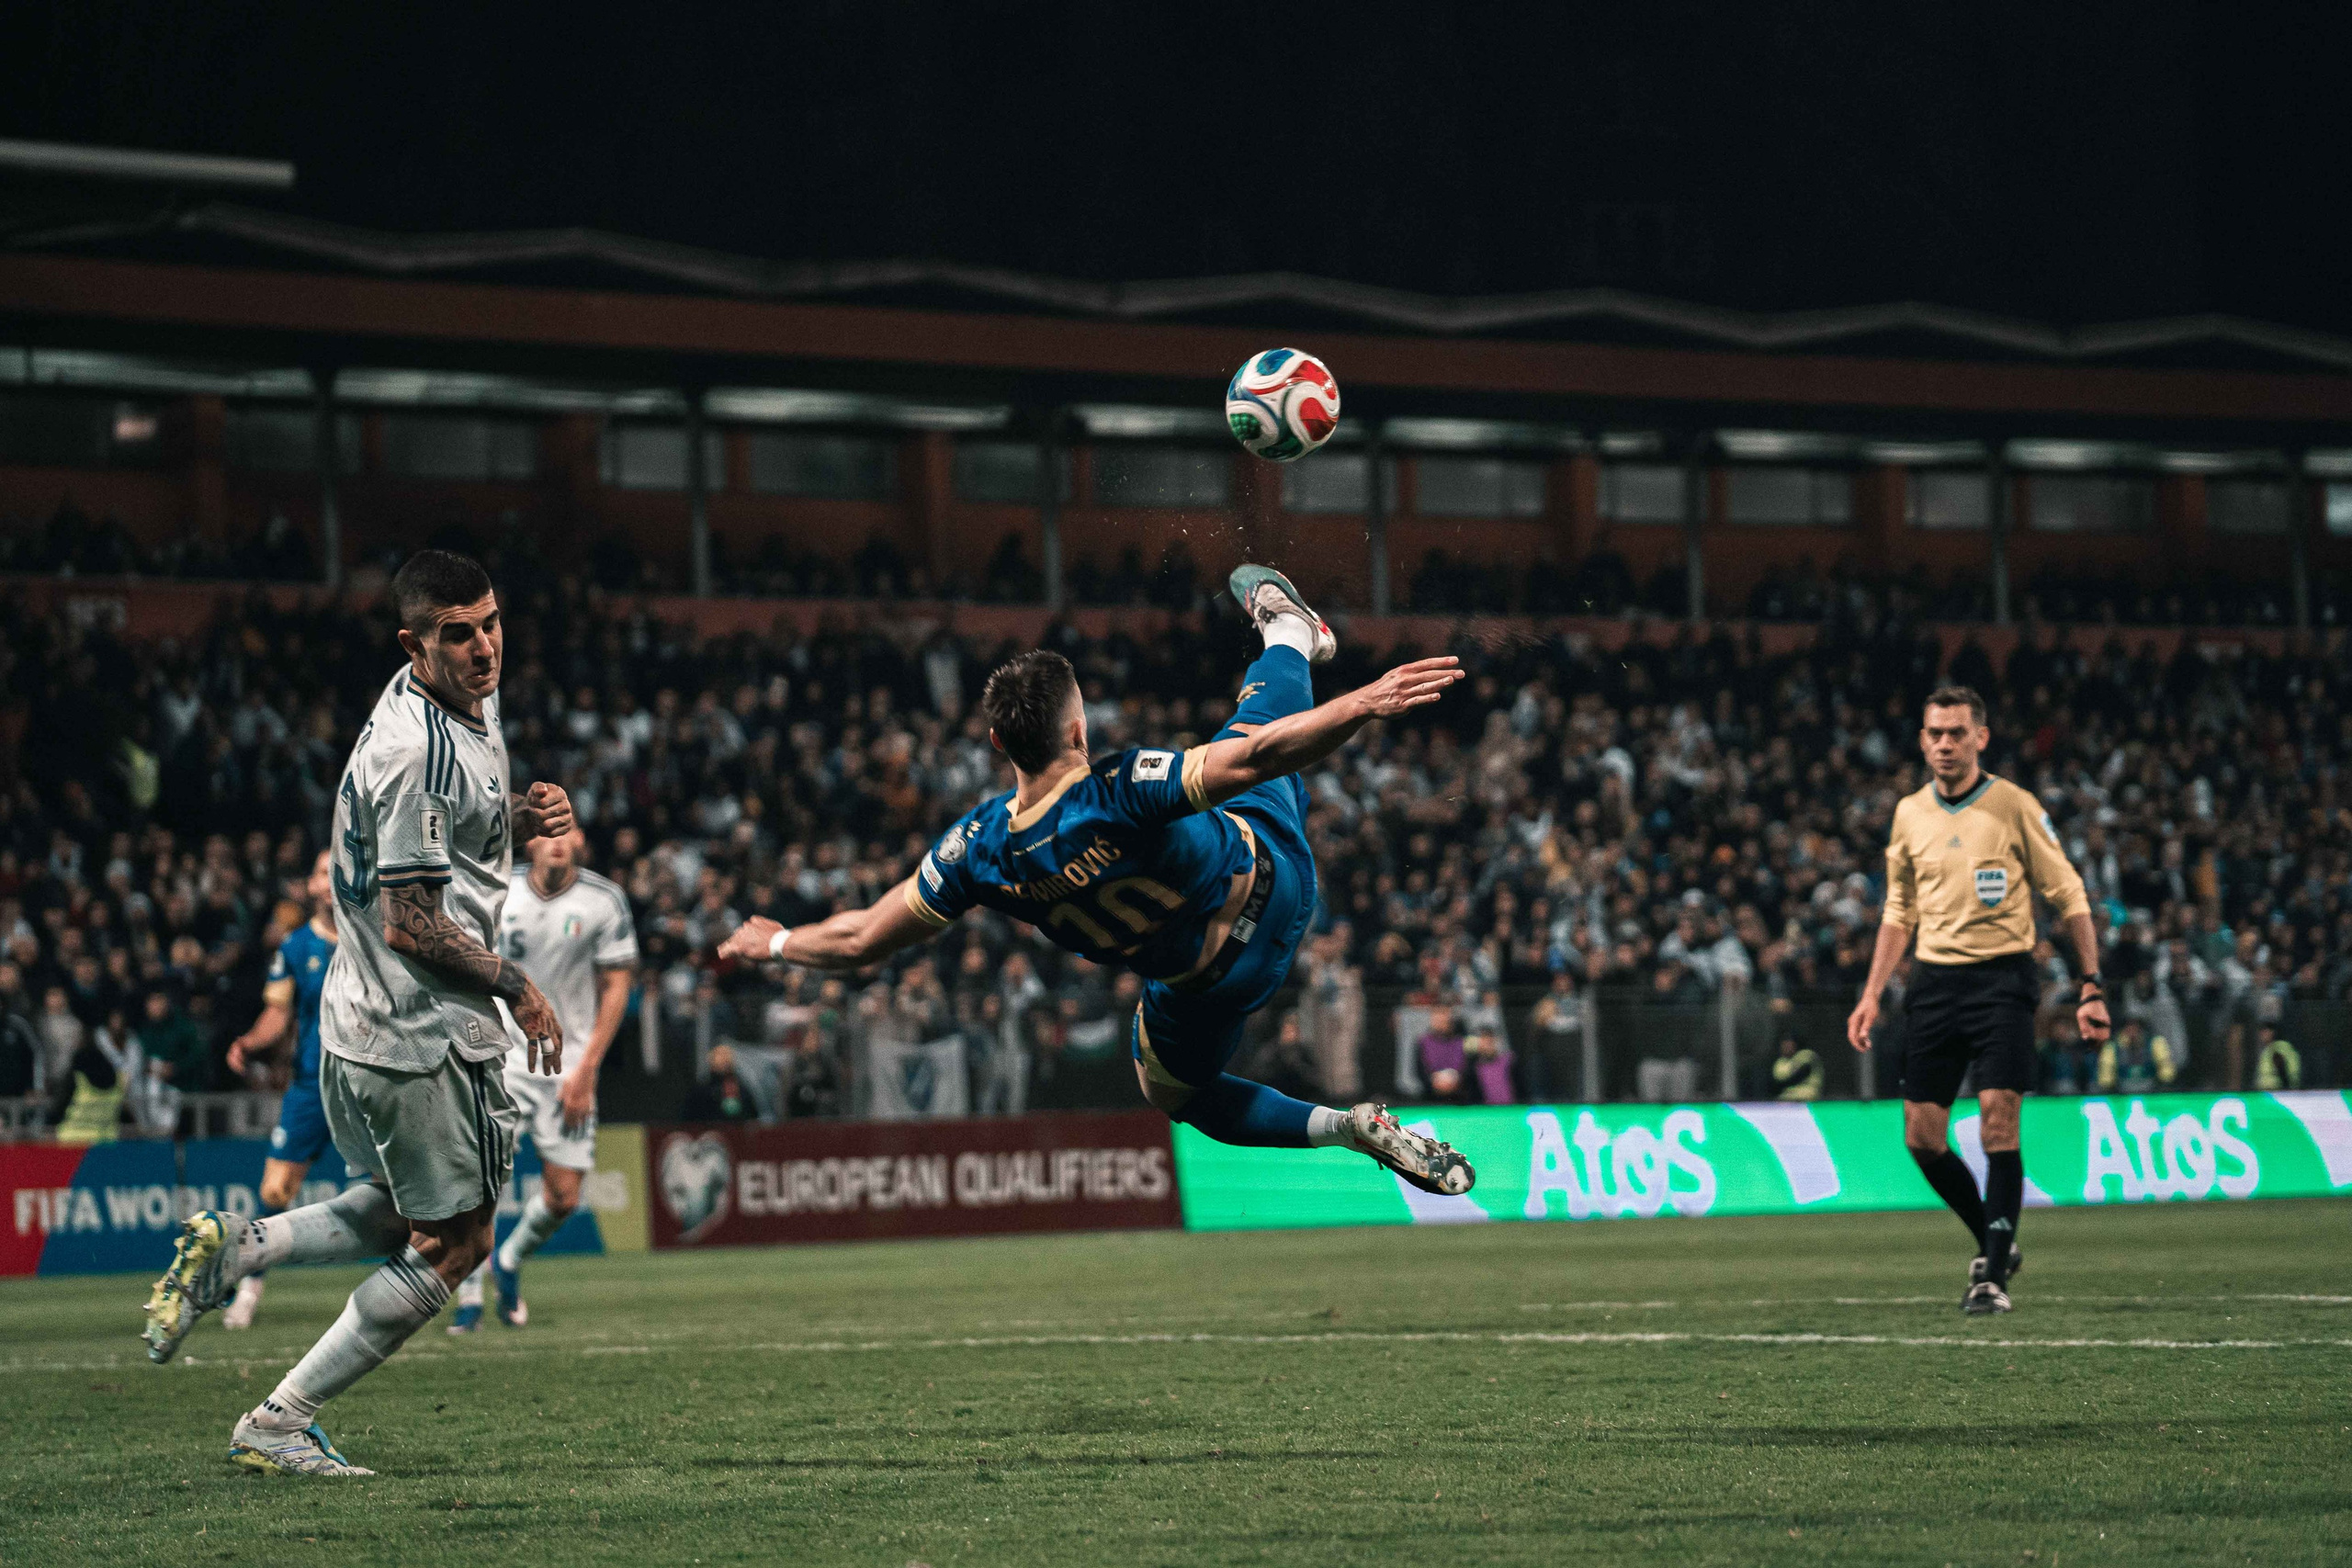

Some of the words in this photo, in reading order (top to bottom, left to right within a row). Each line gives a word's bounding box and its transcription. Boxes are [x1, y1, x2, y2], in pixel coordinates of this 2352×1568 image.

[740, 1155, 947, 1215] EUROPEAN
[955, 1148, 1170, 1210] QUALIFIERS
[13, 1187, 103, 1236] FIFA
